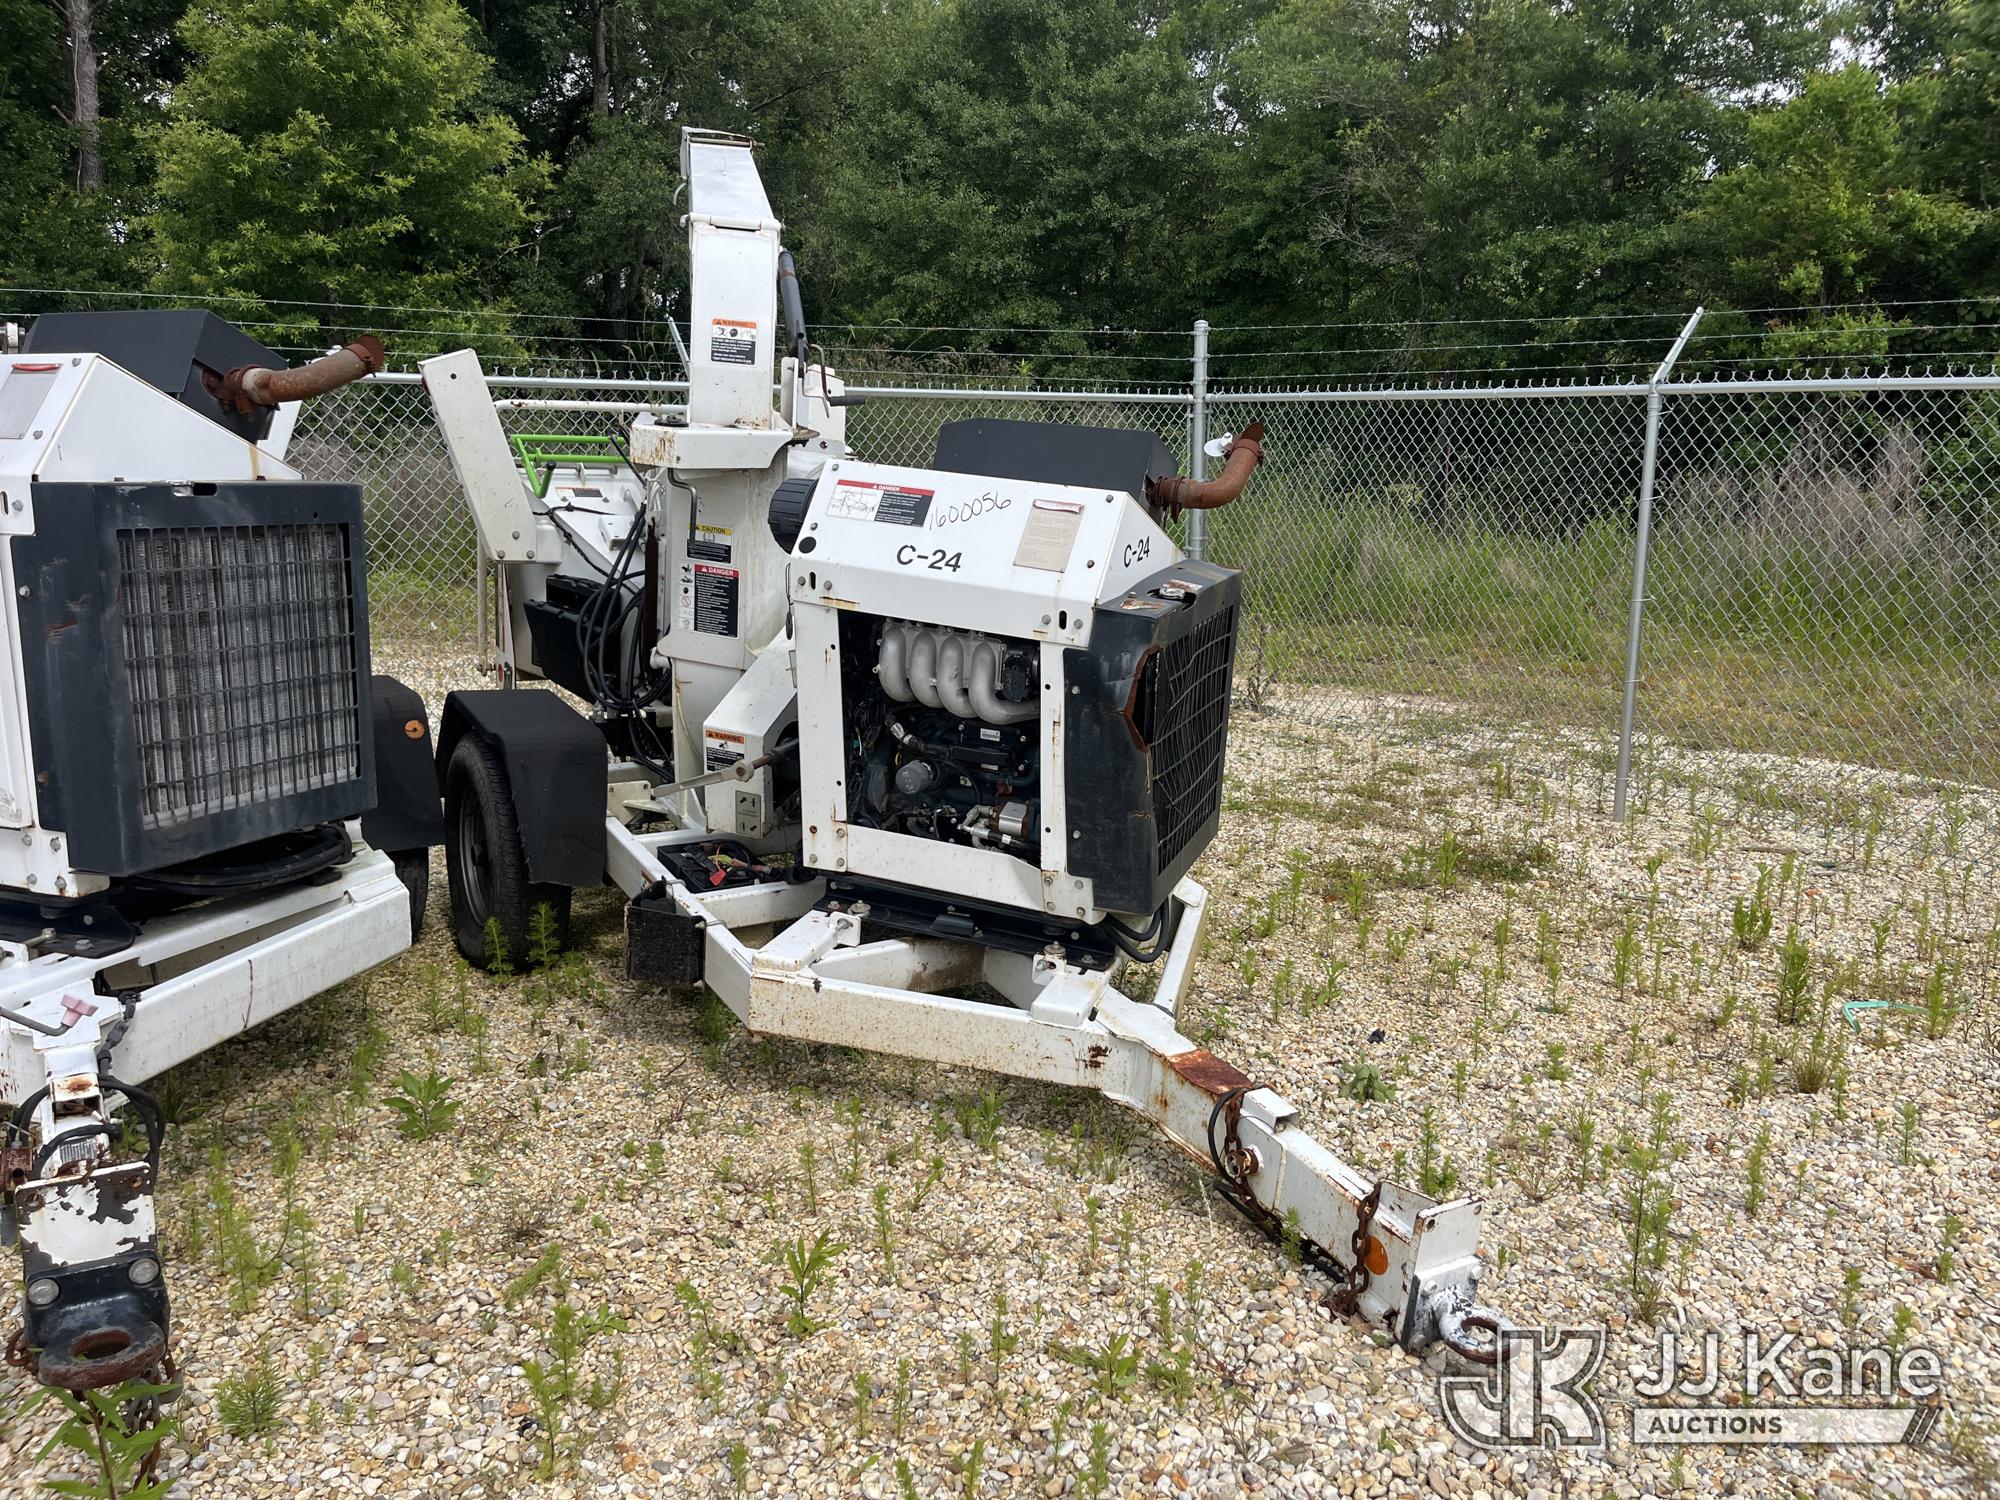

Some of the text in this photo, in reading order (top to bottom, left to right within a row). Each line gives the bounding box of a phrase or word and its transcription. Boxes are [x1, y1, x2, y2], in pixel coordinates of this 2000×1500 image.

[878, 484, 901, 492] DANGER
[928, 491, 1012, 531] 1600056
[701, 525, 726, 534] CAUTION
[1124, 536, 1151, 568] C-24
[896, 544, 962, 573] C-24
[708, 566, 734, 576] DANGER
[714, 732, 741, 742] WARNING
